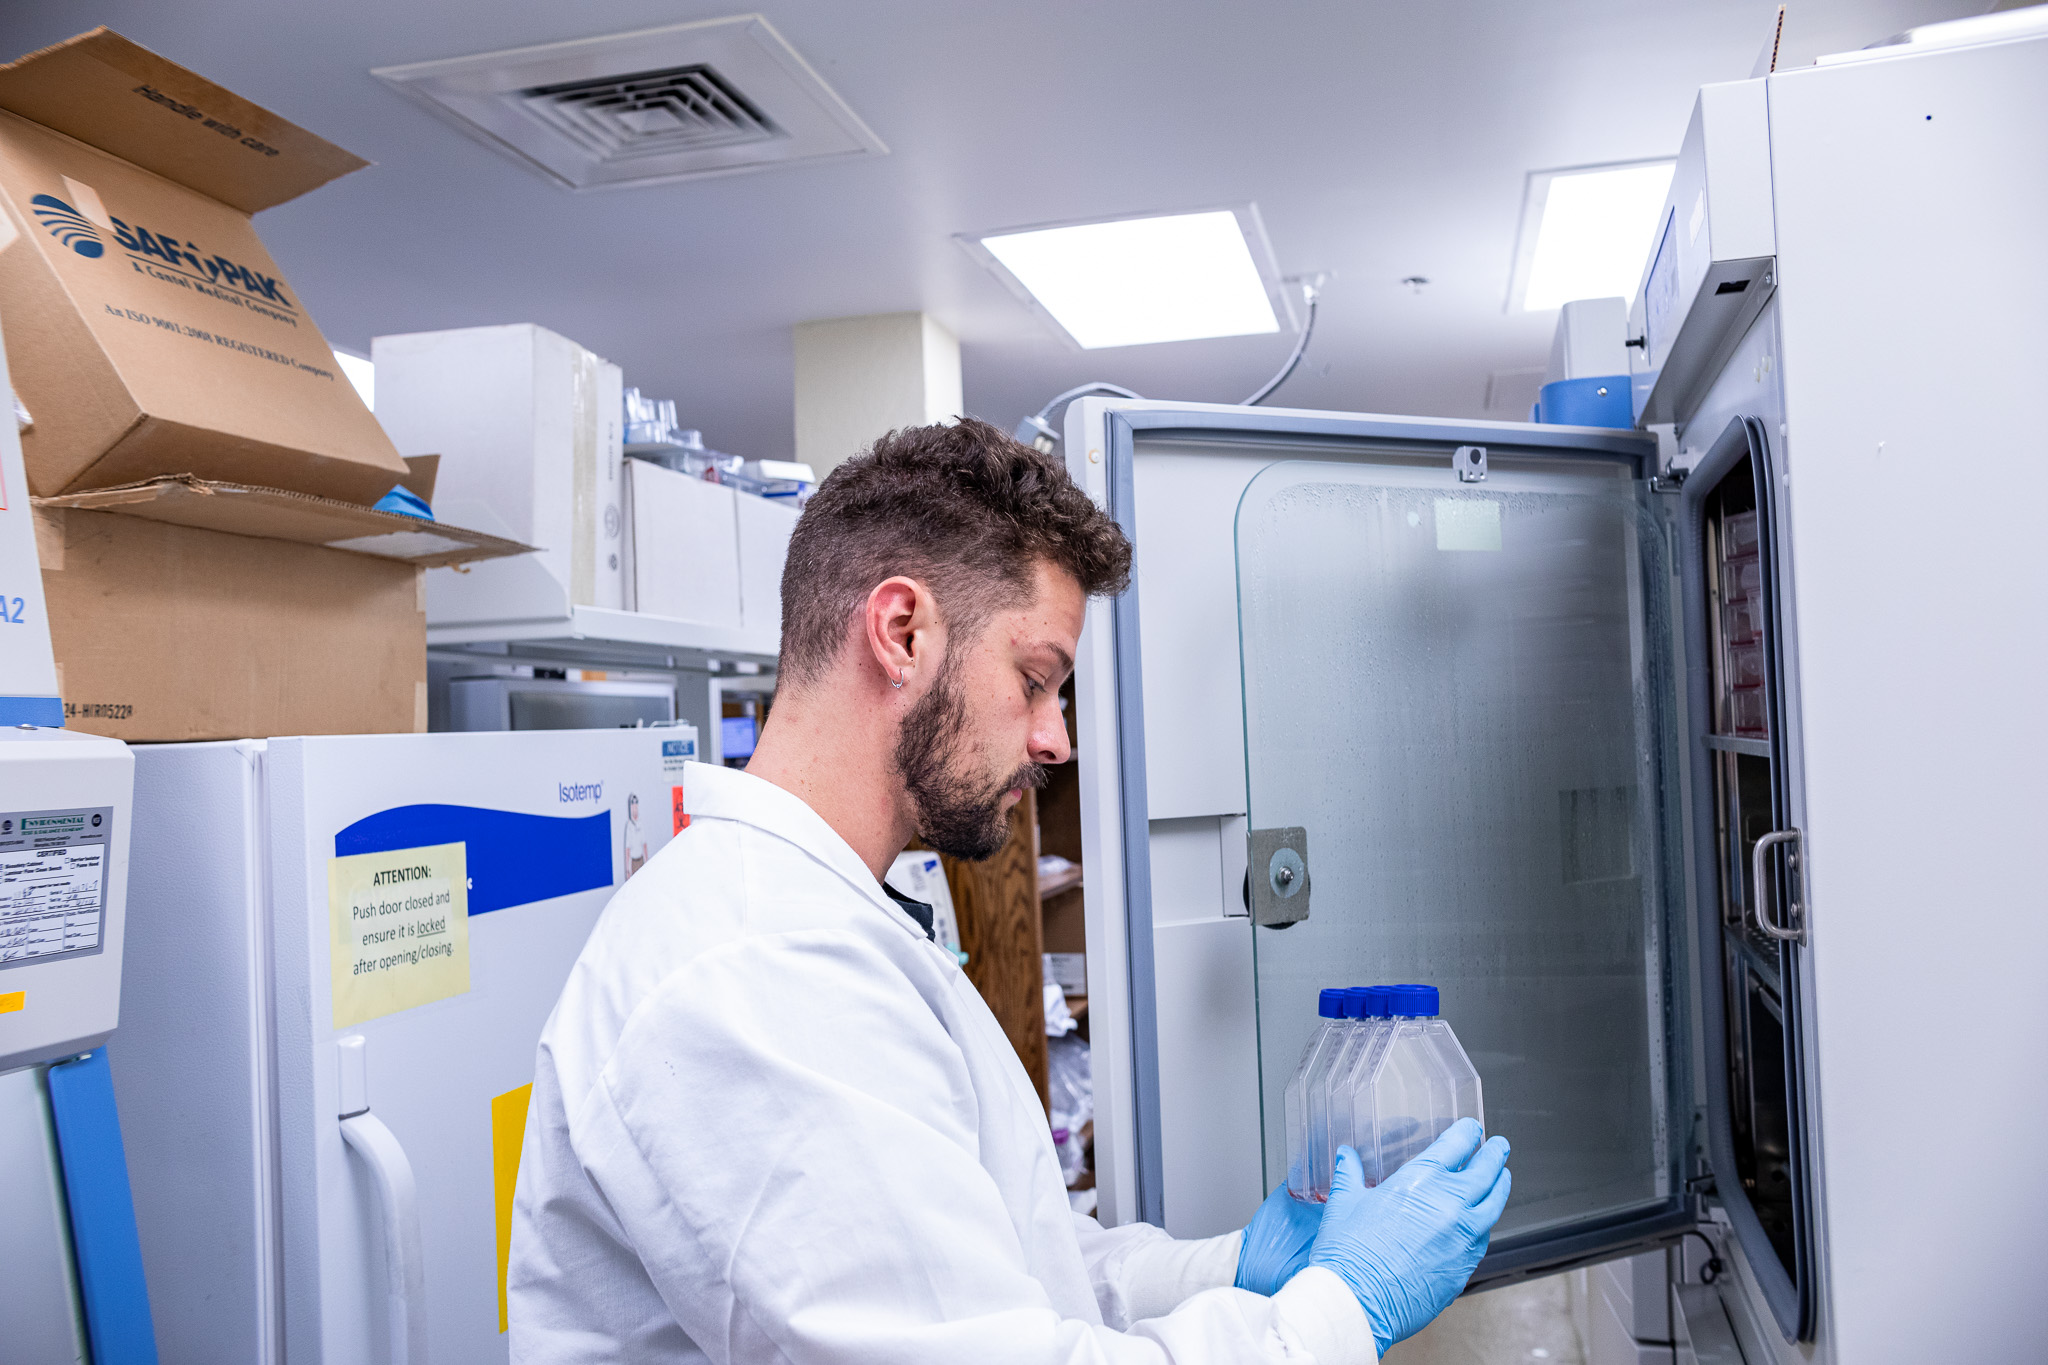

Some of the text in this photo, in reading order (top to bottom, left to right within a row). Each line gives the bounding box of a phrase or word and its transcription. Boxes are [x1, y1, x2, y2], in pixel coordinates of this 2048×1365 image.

[132, 84, 280, 156] Handle with care
[132, 261, 144, 274] A
[194, 281, 244, 306] Medical
[245, 299, 298, 328] Company
[105, 303, 124, 317] An
[125, 308, 150, 324] ISO
[214, 334, 290, 366] REGISTERED
[290, 356, 334, 381] Company
[559, 781, 602, 804] Isotemp
[21, 816, 84, 830] ENVIRONMENTAL
[36, 849, 67, 858] CERTIFIED
[373, 865, 432, 887] ATTENTION:
[353, 890, 450, 920] Push door closed and
[362, 915, 446, 946] ensure it is locked
[353, 941, 454, 975] after opening/closing.
